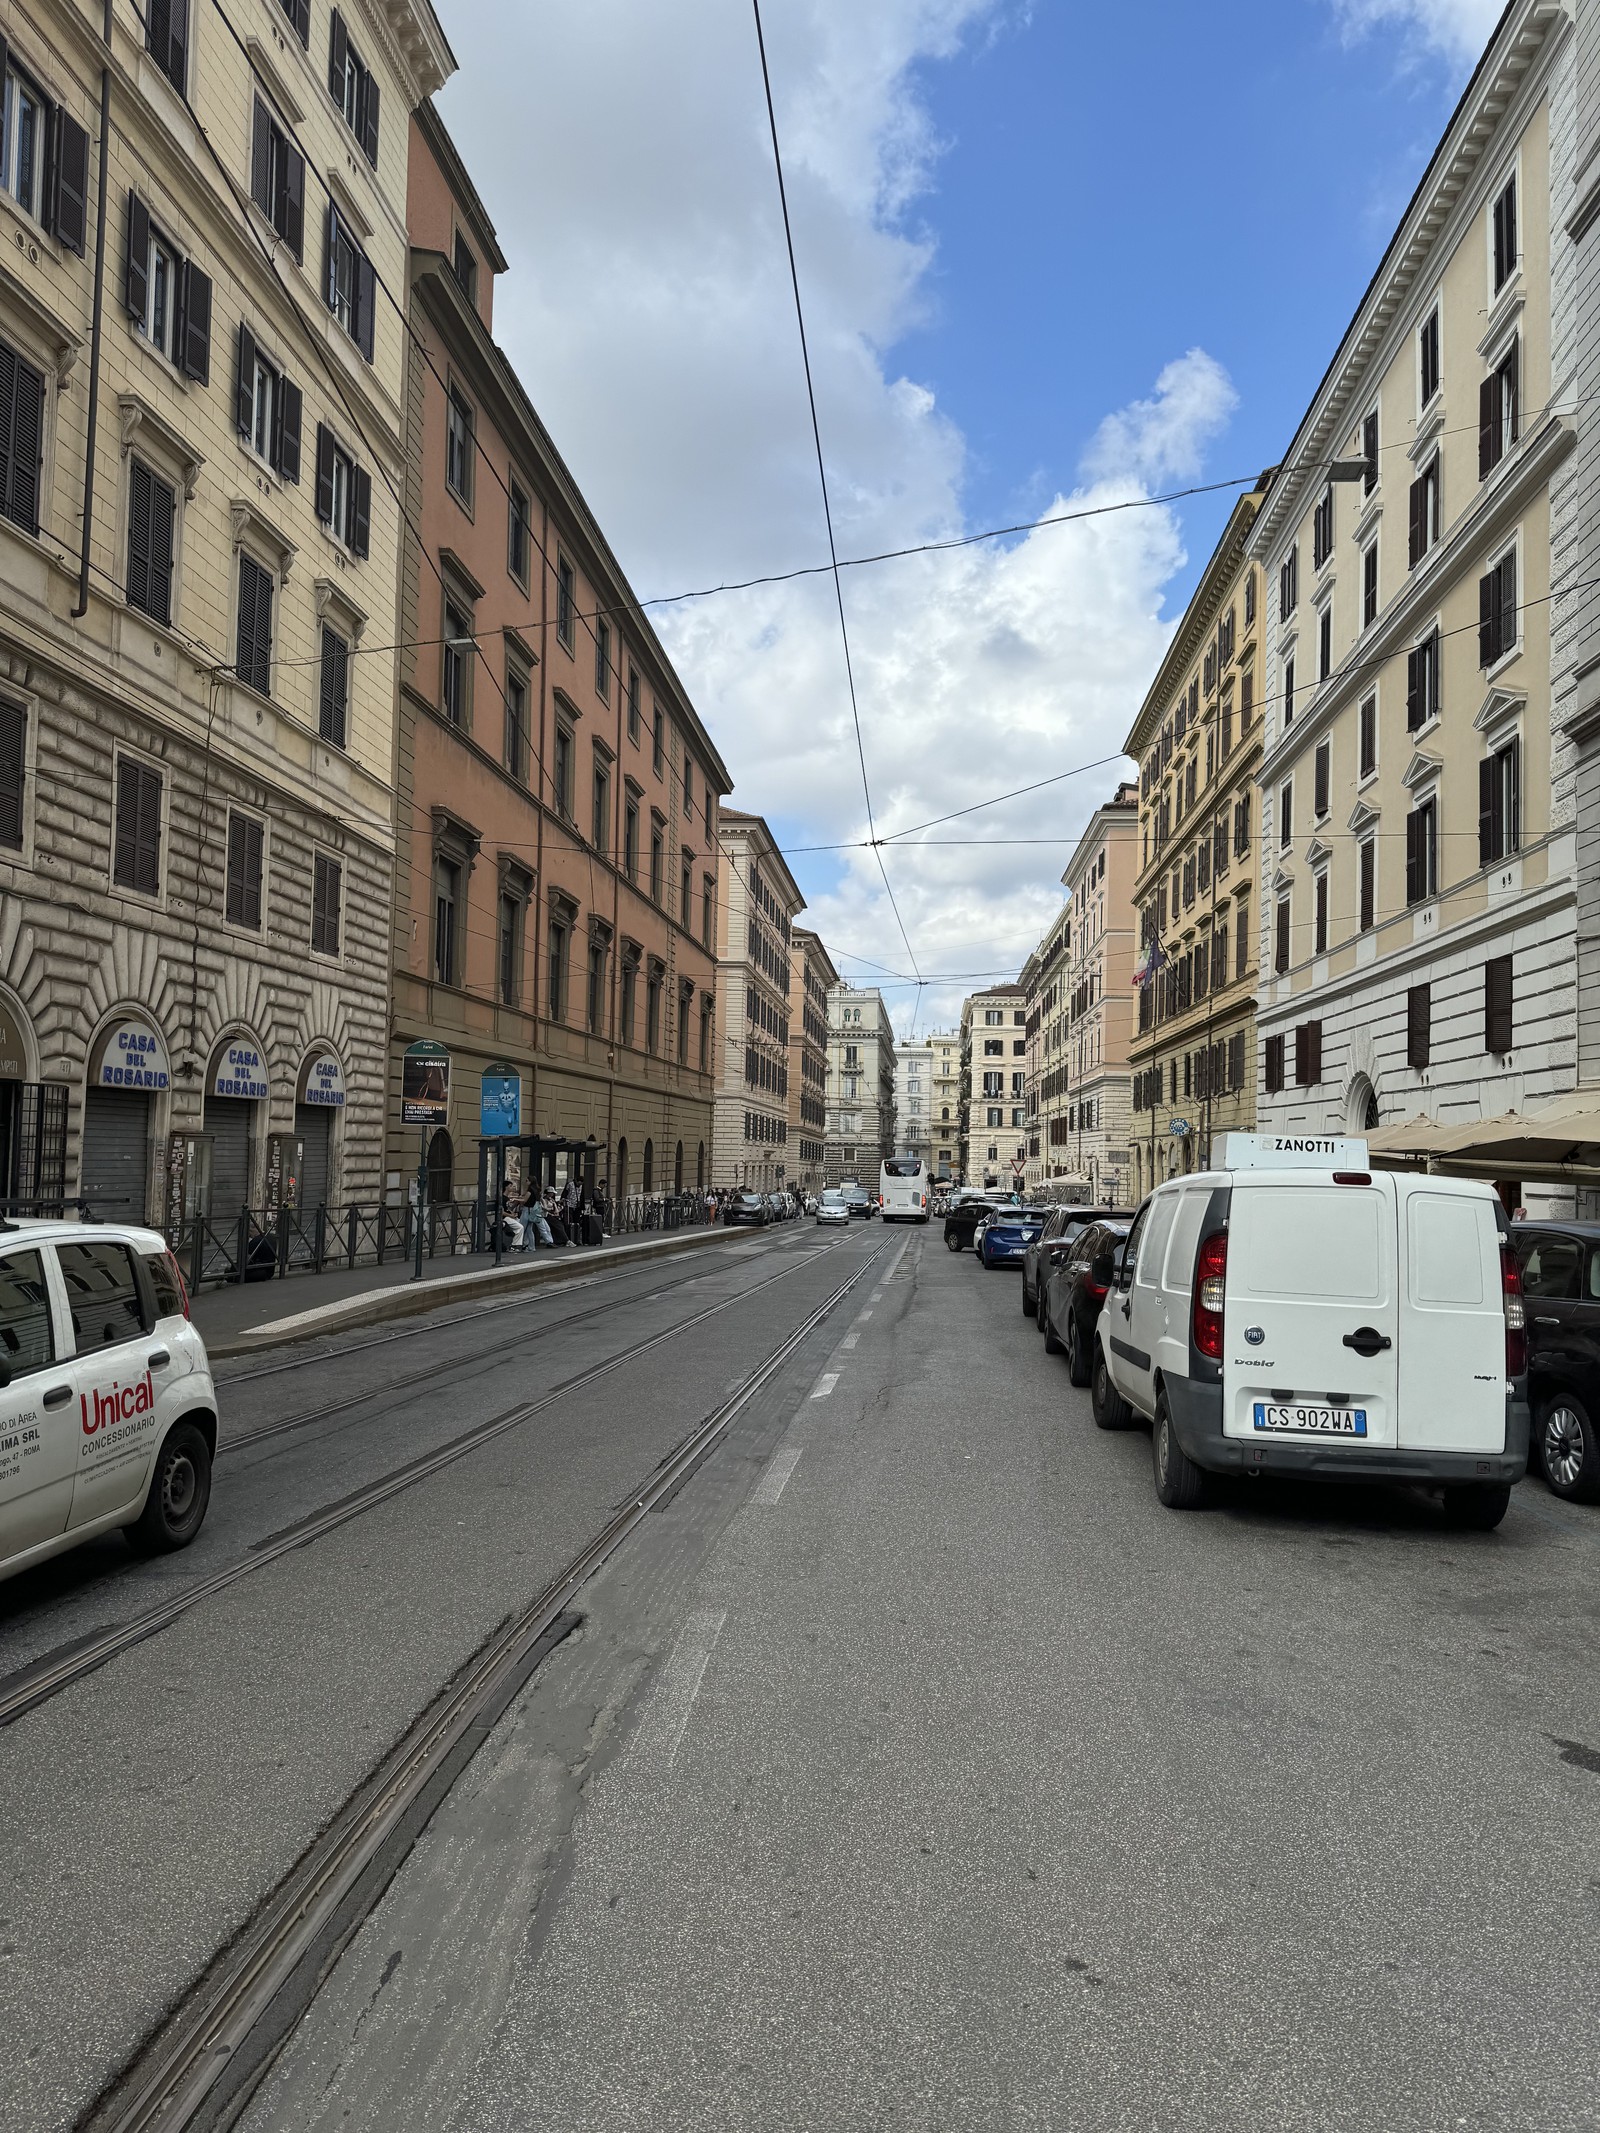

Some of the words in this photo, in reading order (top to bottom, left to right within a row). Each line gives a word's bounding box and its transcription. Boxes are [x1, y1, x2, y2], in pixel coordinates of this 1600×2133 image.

[118, 1032, 157, 1053] CASA
[126, 1052, 147, 1067] DEL
[229, 1049, 259, 1067] CASA
[103, 1065, 168, 1088] ROSARIO
[234, 1067, 252, 1079] DEL
[316, 1063, 338, 1078] CASA
[217, 1078, 268, 1098] ROSARIO
[320, 1078, 333, 1089] DEL
[306, 1088, 344, 1105] ROSARIO
[1275, 1139, 1335, 1154] ZANOTTI
[1247, 1331, 1262, 1339] FIAT
[80, 1370, 154, 1435] Unical
[9, 1418, 16, 1428] DI
[18, 1411, 37, 1425] AREA
[1267, 1406, 1289, 1426] CS
[1296, 1409, 1353, 1431] 902WA
[0, 1436, 19, 1452] IMA
[22, 1428, 40, 1443] SRL
[82, 1415, 155, 1456] CONCESSIONARIO
[23, 1444, 40, 1457] ROMA
